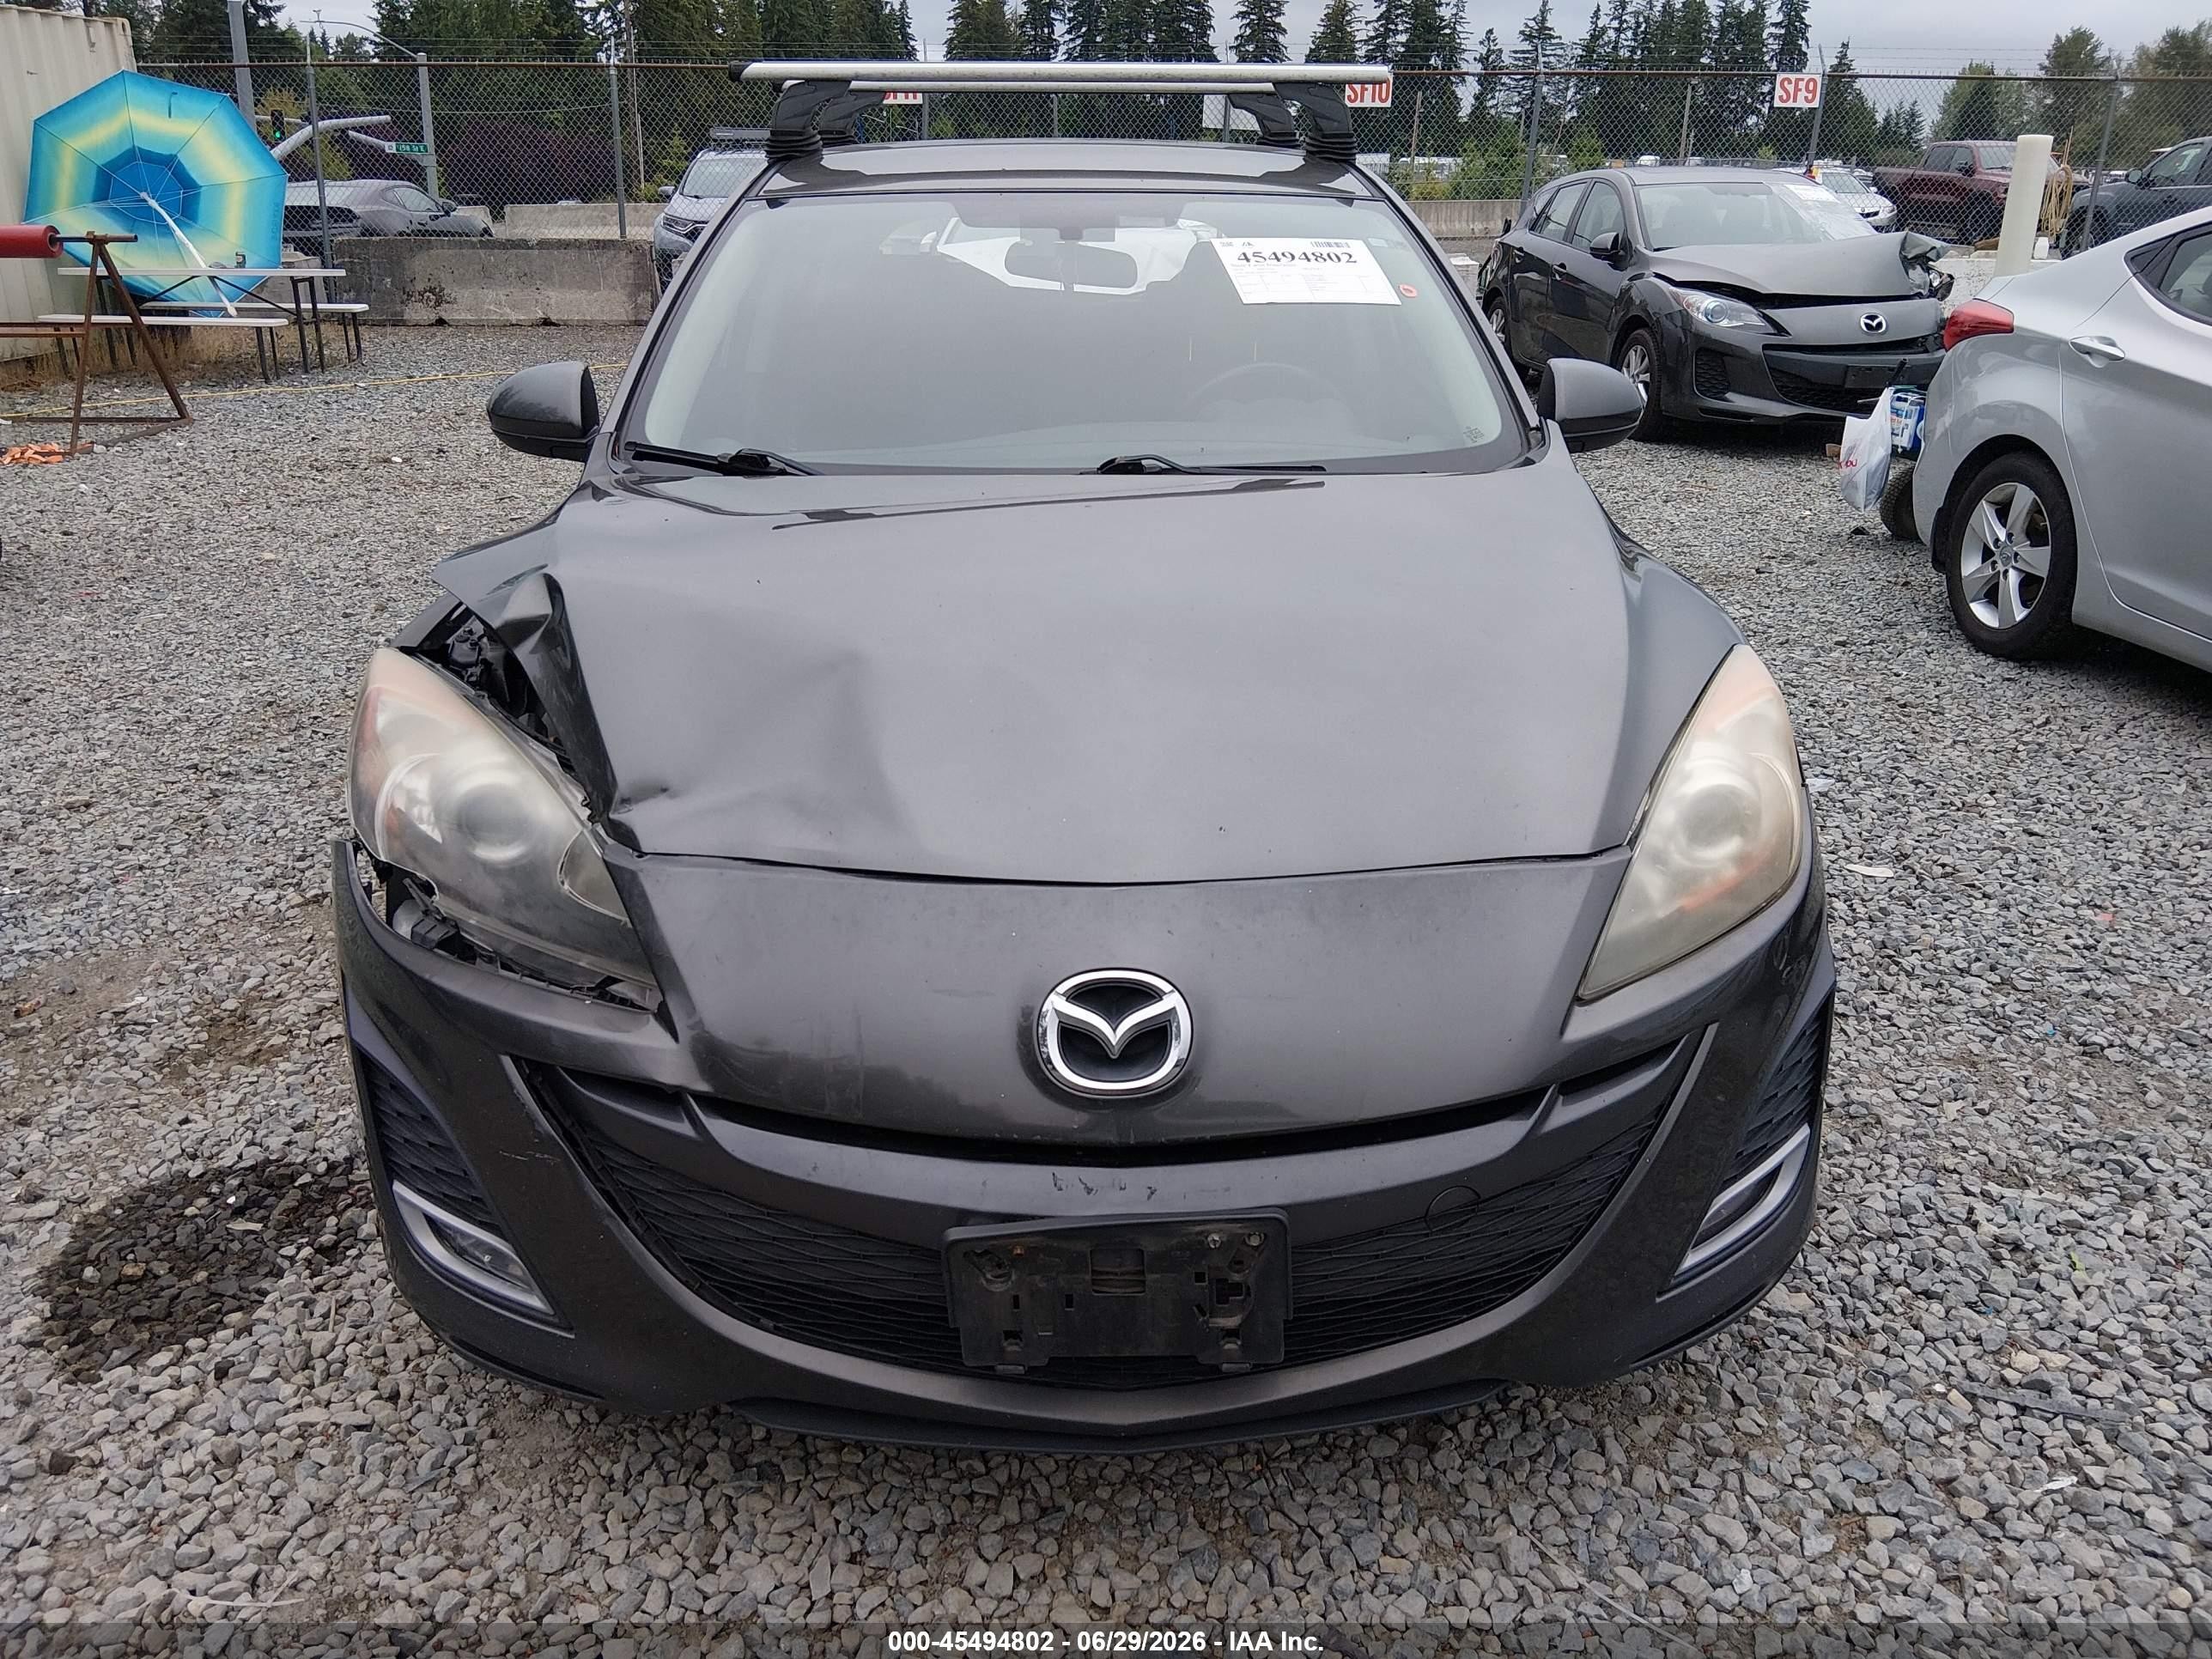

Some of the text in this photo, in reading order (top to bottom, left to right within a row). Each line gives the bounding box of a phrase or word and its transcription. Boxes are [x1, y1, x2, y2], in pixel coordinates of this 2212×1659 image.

[1346, 80, 1391, 104] SF10
[1778, 76, 1818, 104] SF9
[1237, 251, 1357, 264] 45494802
